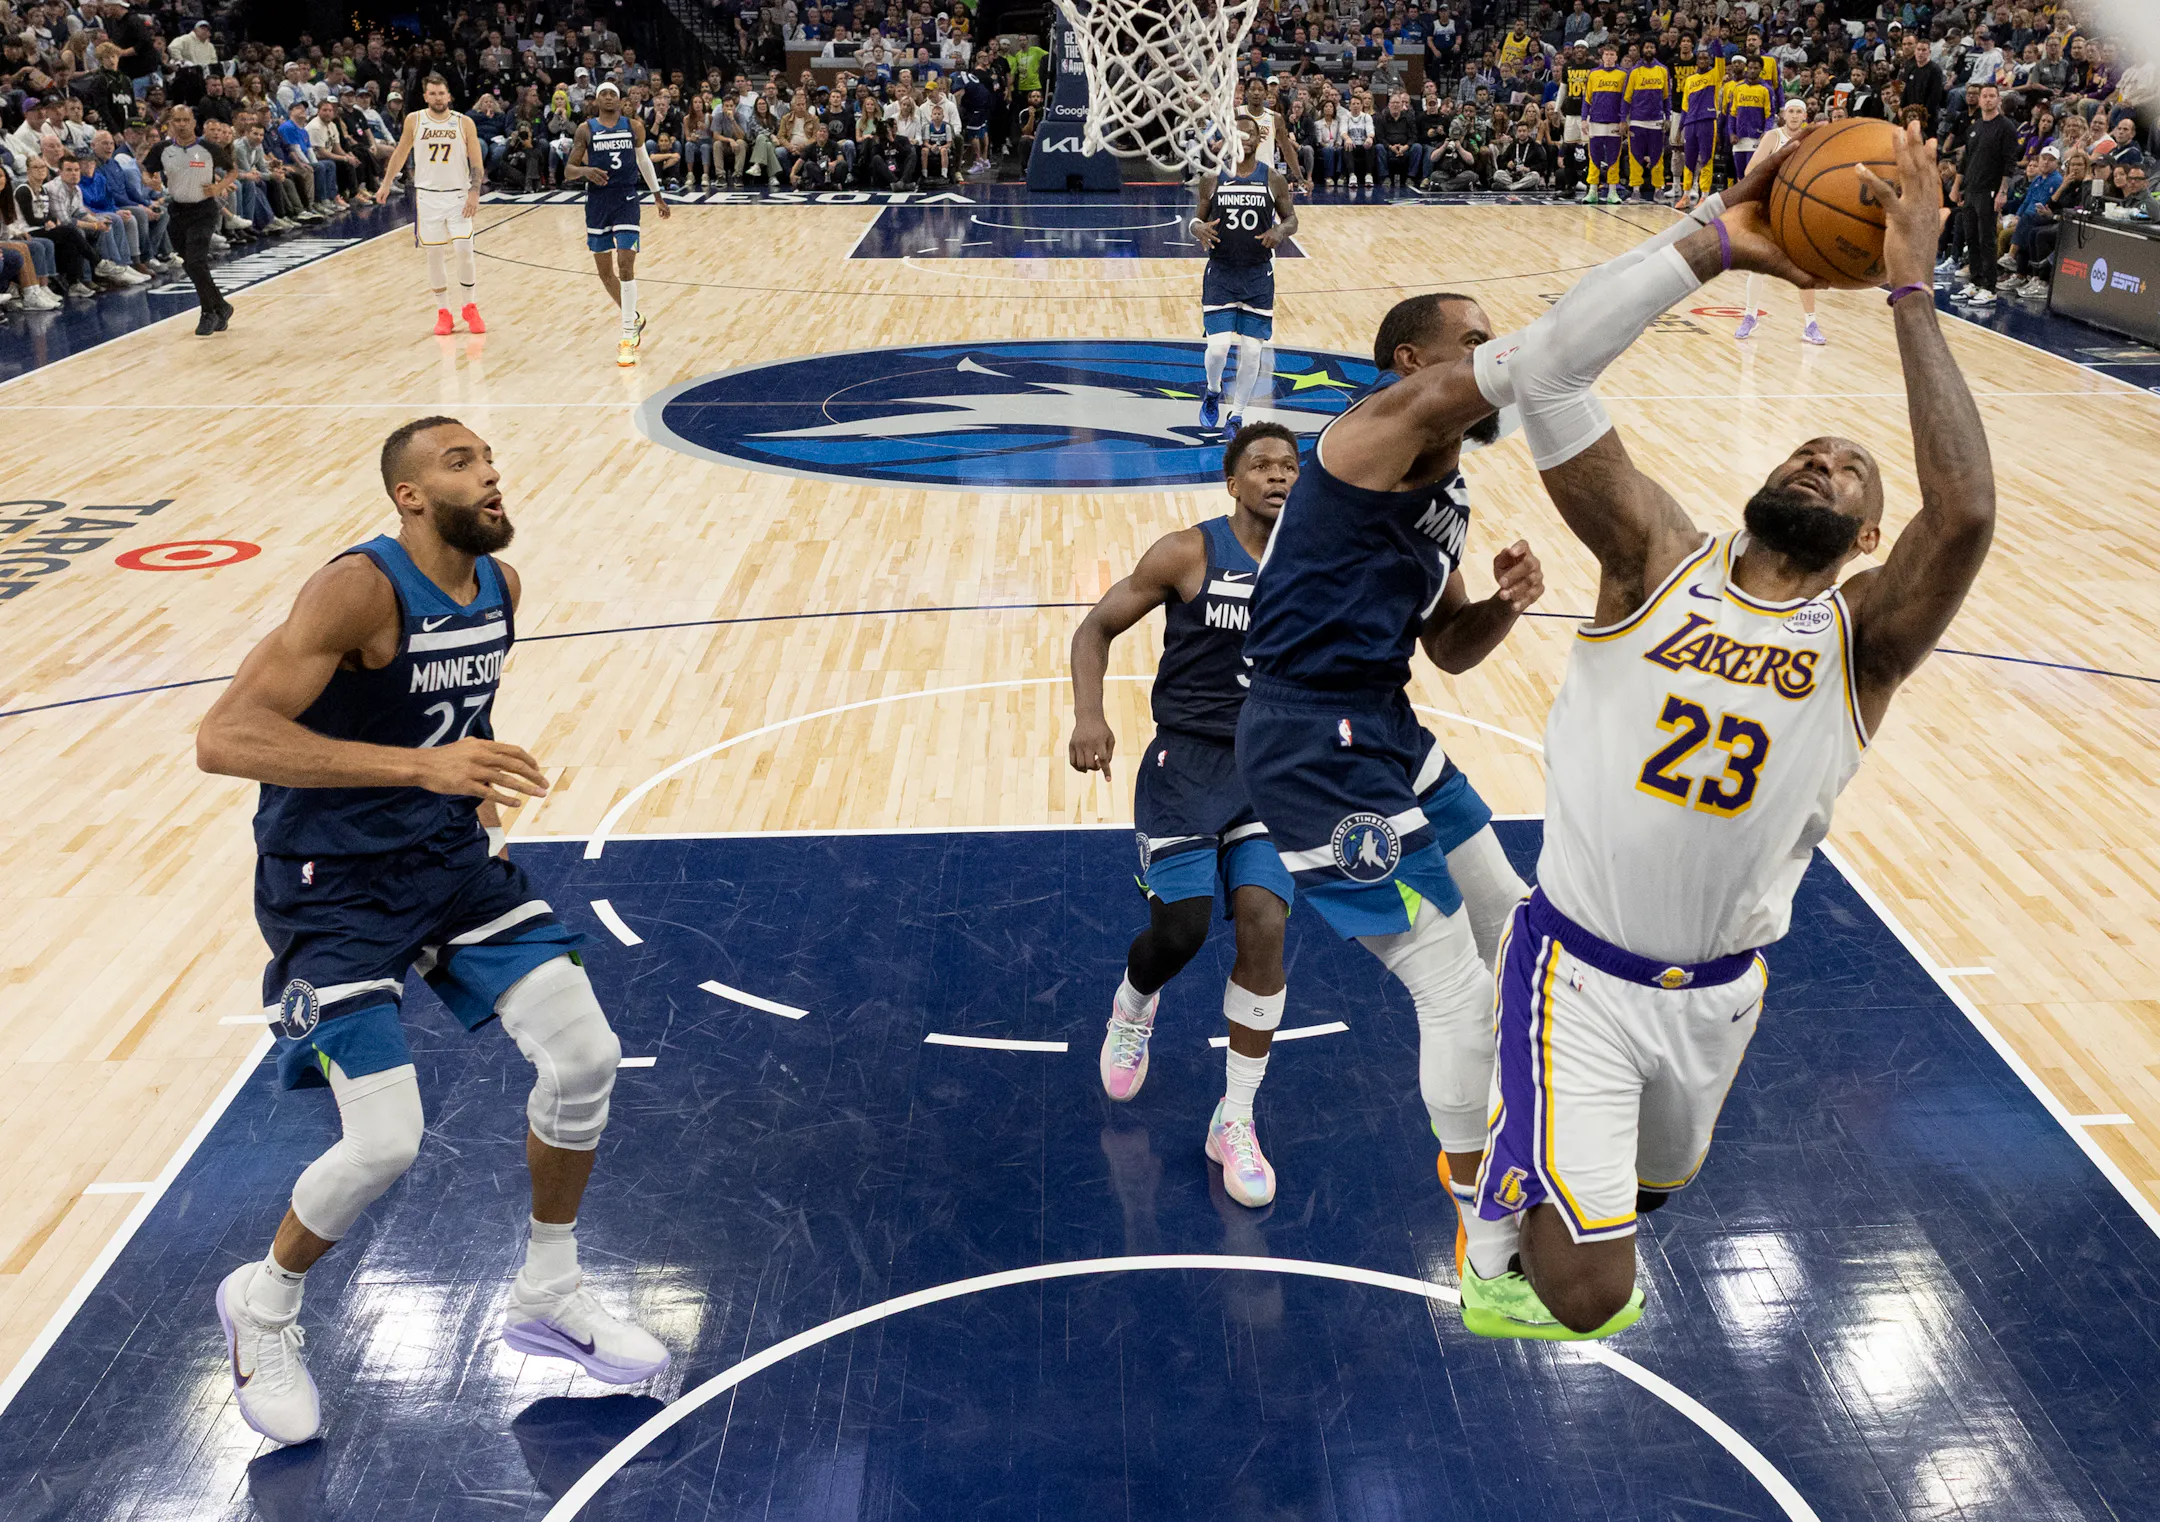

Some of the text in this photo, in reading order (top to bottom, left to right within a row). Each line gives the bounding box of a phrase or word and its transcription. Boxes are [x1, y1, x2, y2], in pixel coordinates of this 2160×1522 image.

[1064, 45, 1080, 58] THE
[960, 71, 980, 84] 10
[1568, 70, 1590, 78] WIN
[420, 127, 456, 140] LAKERS
[593, 138, 633, 152] MINNESOTA
[428, 143, 451, 163] 77
[609, 151, 623, 170] 3
[478, 191, 976, 203] MINESOTA
[1217, 194, 1266, 207] MINNESOTA
[1225, 208, 1259, 231] 30
[2092, 267, 2106, 282] abc
[1643, 611, 1820, 702] LAKERS
[418, 692, 492, 748] 27
[1635, 693, 1772, 819] 23
[1355, 816, 1398, 862] TIMBERWOLVES
[1252, 1007, 1264, 1017] 5
